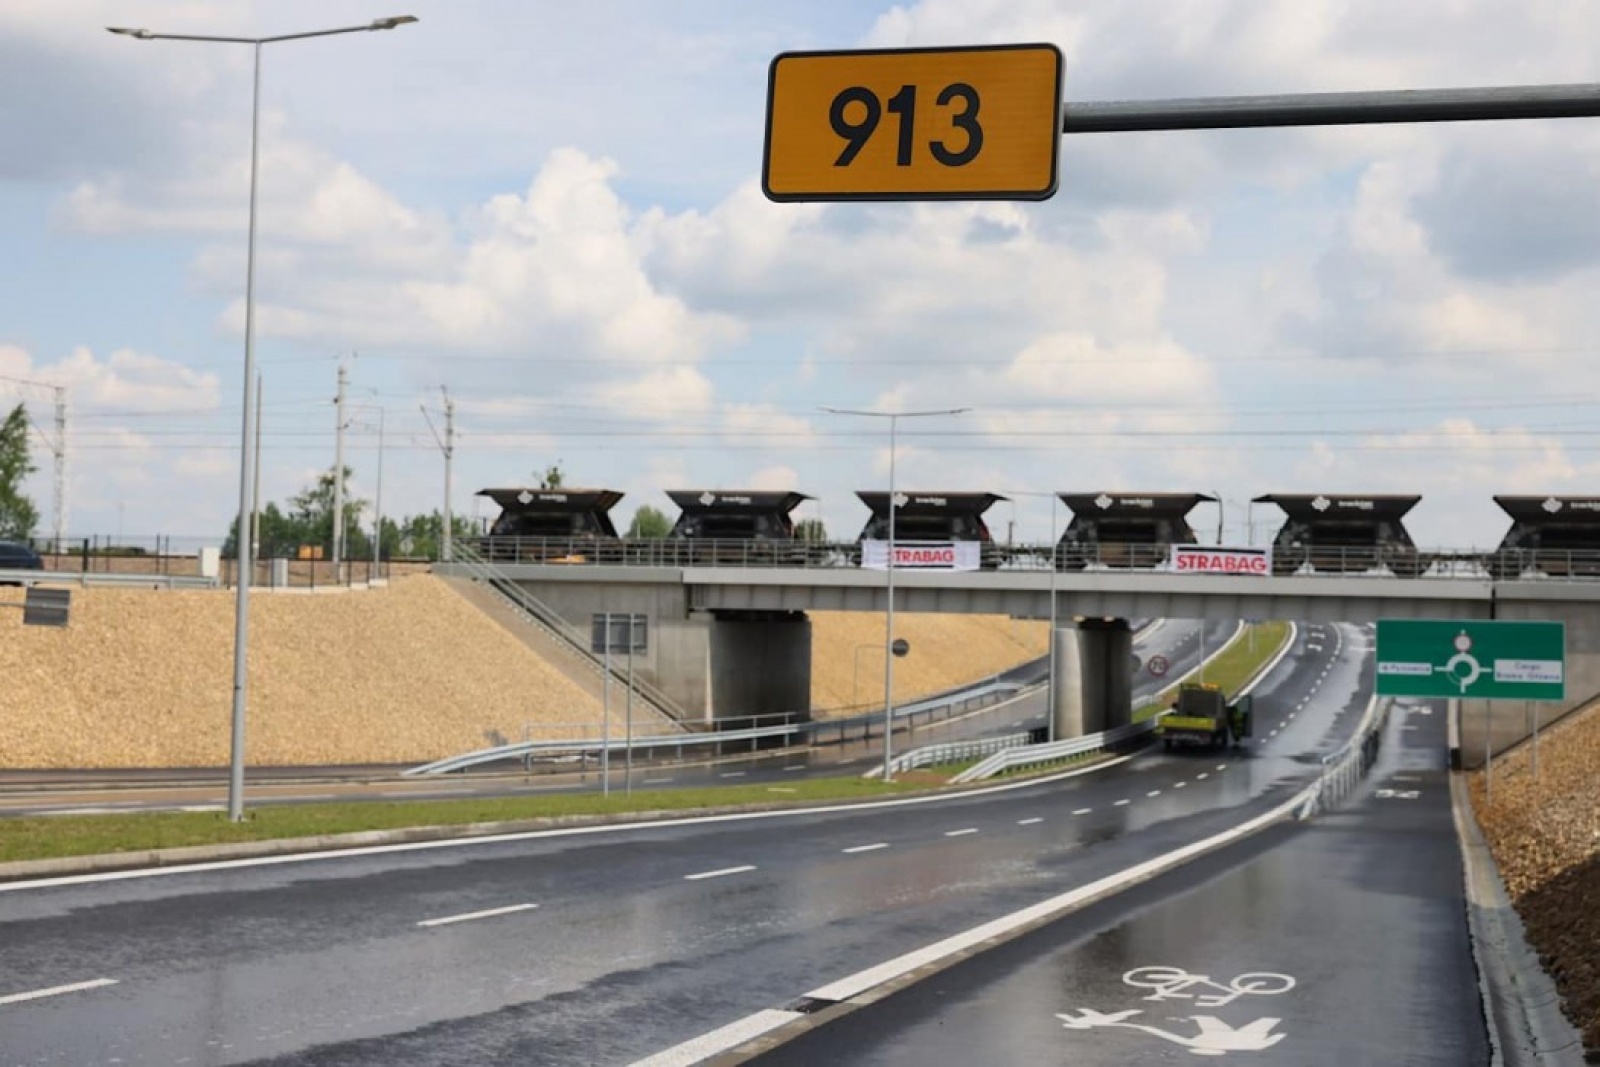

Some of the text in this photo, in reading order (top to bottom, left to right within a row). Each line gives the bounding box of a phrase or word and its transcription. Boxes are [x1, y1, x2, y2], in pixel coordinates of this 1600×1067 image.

[828, 83, 984, 167] 913
[888, 549, 954, 562] TRABAG
[1177, 554, 1266, 572] STRABAG
